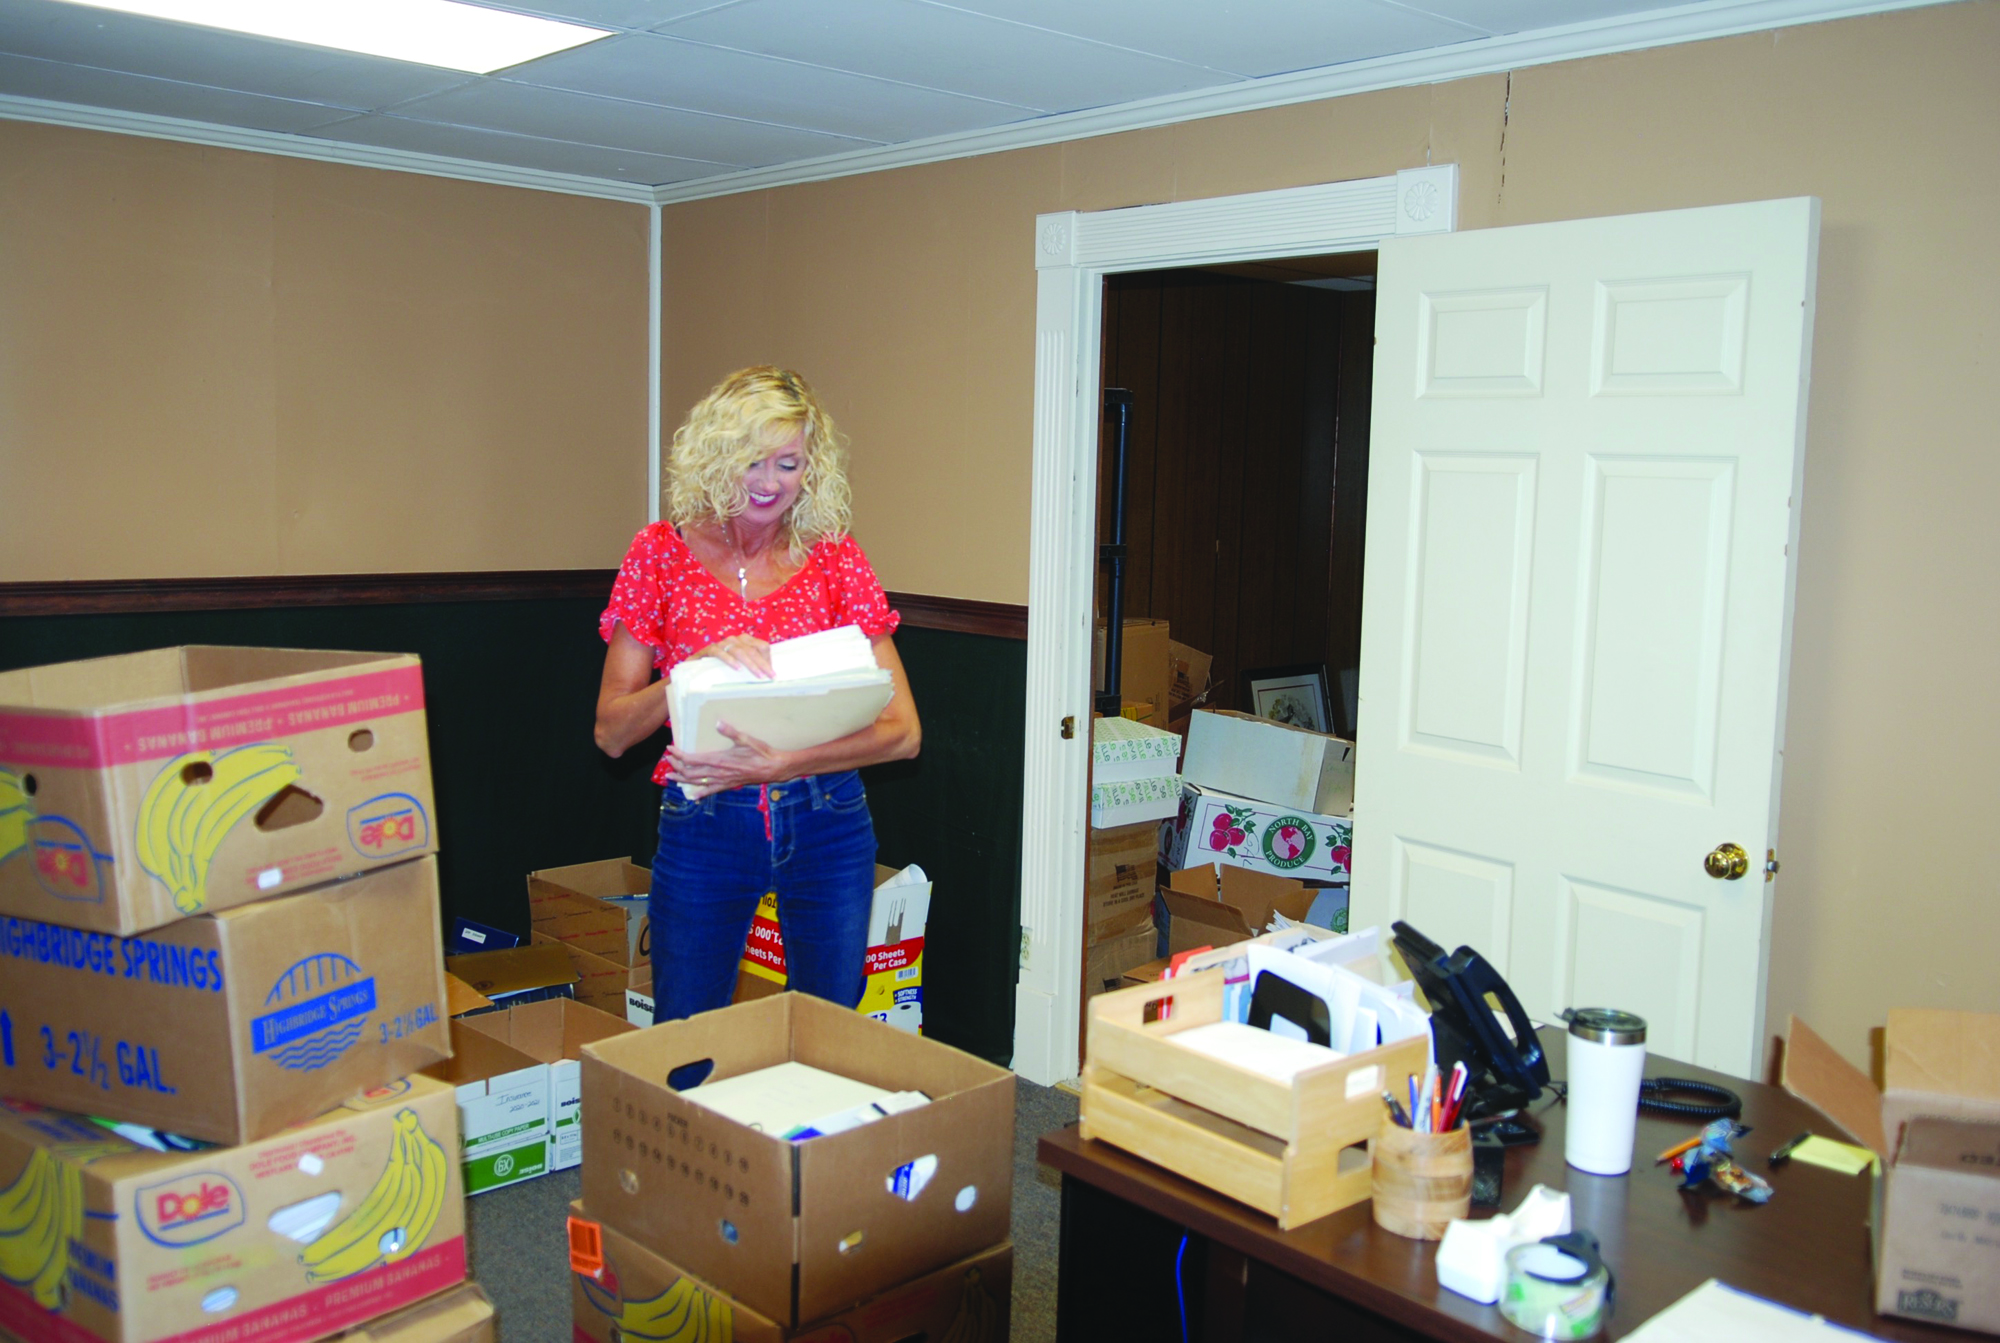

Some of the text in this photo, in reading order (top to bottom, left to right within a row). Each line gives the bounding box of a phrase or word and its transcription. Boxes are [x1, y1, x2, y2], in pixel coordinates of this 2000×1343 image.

[360, 814, 415, 850] Dole
[1268, 817, 1314, 840] NORTH BAY
[1265, 850, 1306, 868] PRODUCE
[120, 938, 223, 993] SPRINGS
[767, 950, 782, 965] Per
[873, 957, 907, 971] Per Case
[878, 948, 905, 961] Sheets
[263, 988, 369, 1046] HIGHBRIDGE SPRINGS
[116, 1040, 178, 1095] GAL.
[156, 1182, 230, 1224] Dole
[325, 1253, 441, 1308] PREMIUM BANANAS
